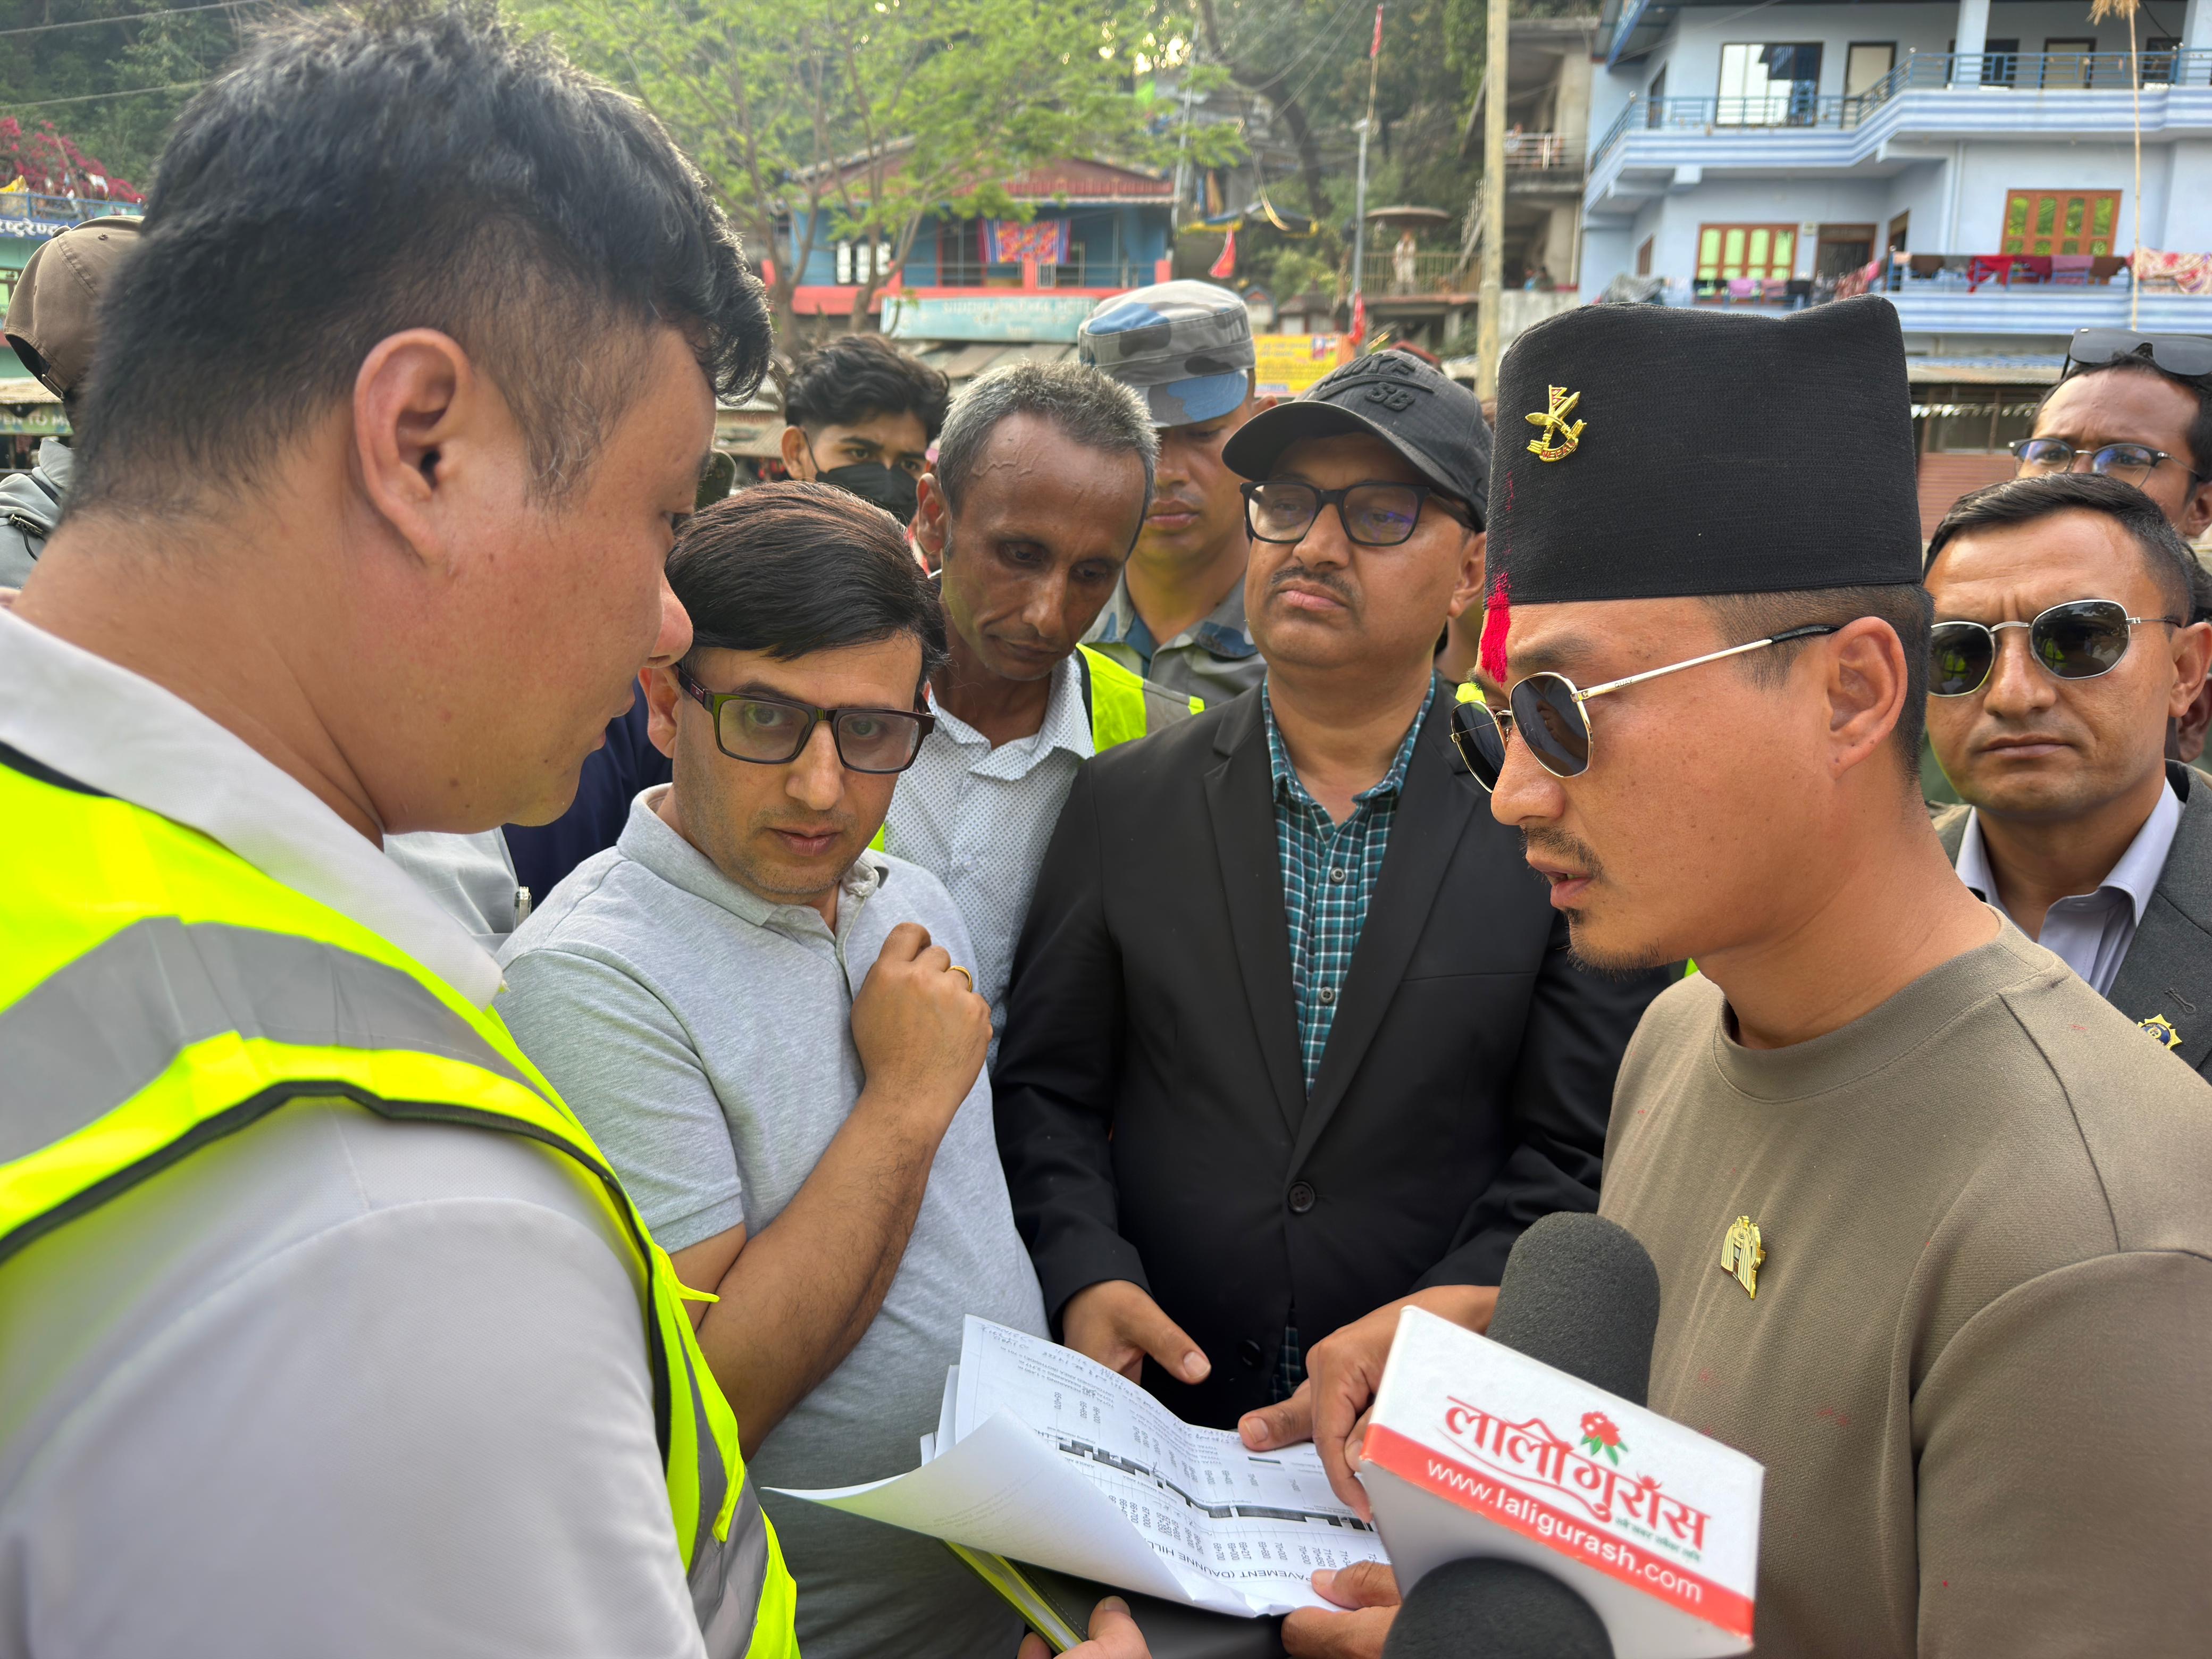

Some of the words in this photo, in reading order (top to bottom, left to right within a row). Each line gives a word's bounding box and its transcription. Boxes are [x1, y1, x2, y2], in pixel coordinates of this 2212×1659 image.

[1364, 382, 1415, 412] SB
[1541, 441, 1576, 459] NEPAL
[1129, 1502, 1138, 1523] 66+700
[1142, 1506, 1151, 1528] 67+000
[1427, 1459, 1702, 1603] www.laligurash.com
[1213, 1542, 1226, 1561] 68+700
[1238, 1541, 1252, 1560] 69+217
[1275, 1542, 1288, 1561] 70+000
[1298, 1545, 1311, 1565] 70+500
[1322, 1548, 1337, 1568] 71+000
[1178, 1551, 1235, 1579] (DAUNNE
